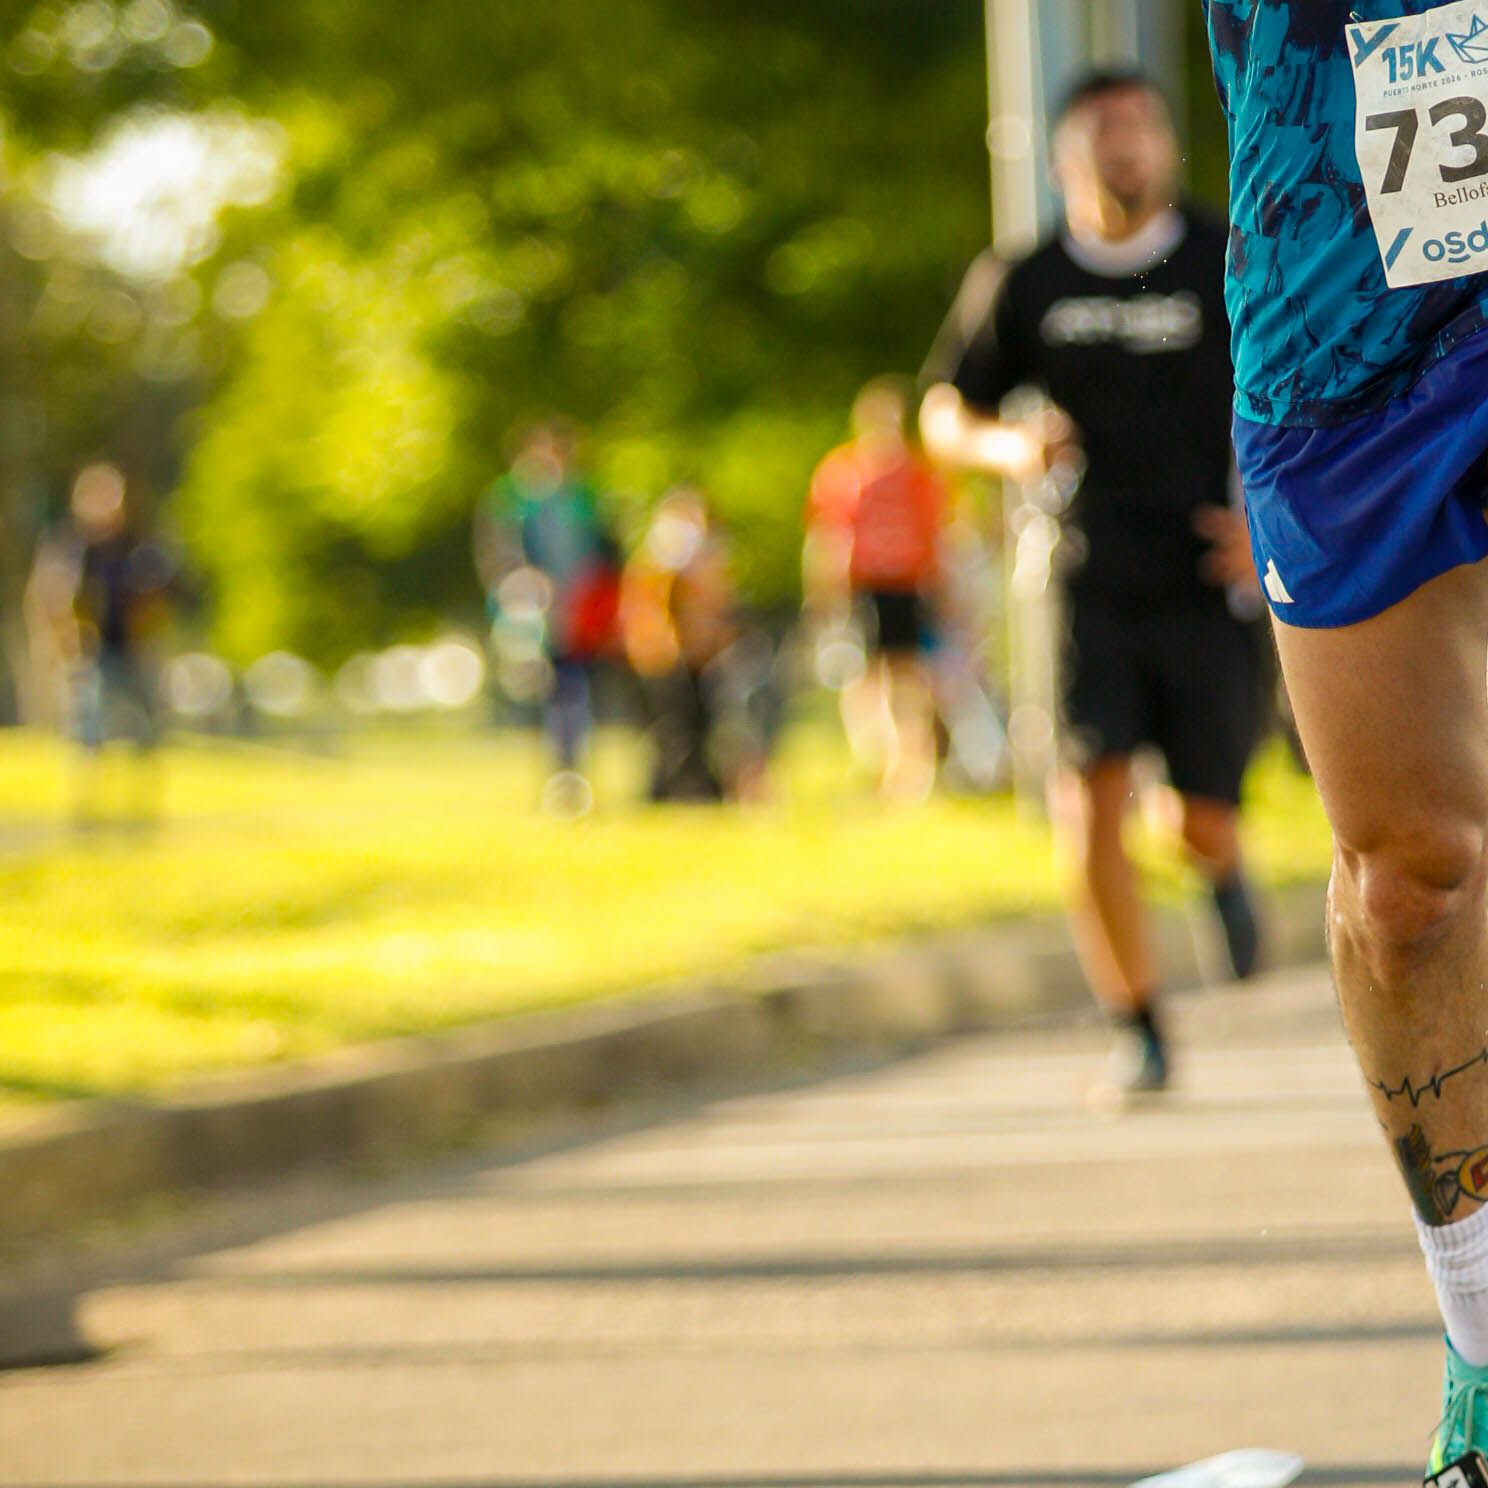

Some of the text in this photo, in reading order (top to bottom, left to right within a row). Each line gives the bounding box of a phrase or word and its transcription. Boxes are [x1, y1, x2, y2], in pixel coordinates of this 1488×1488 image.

[1381, 35, 1446, 84] 15K
[1411, 81, 1438, 91] NORTE
[1441, 75, 1461, 86] 2026
